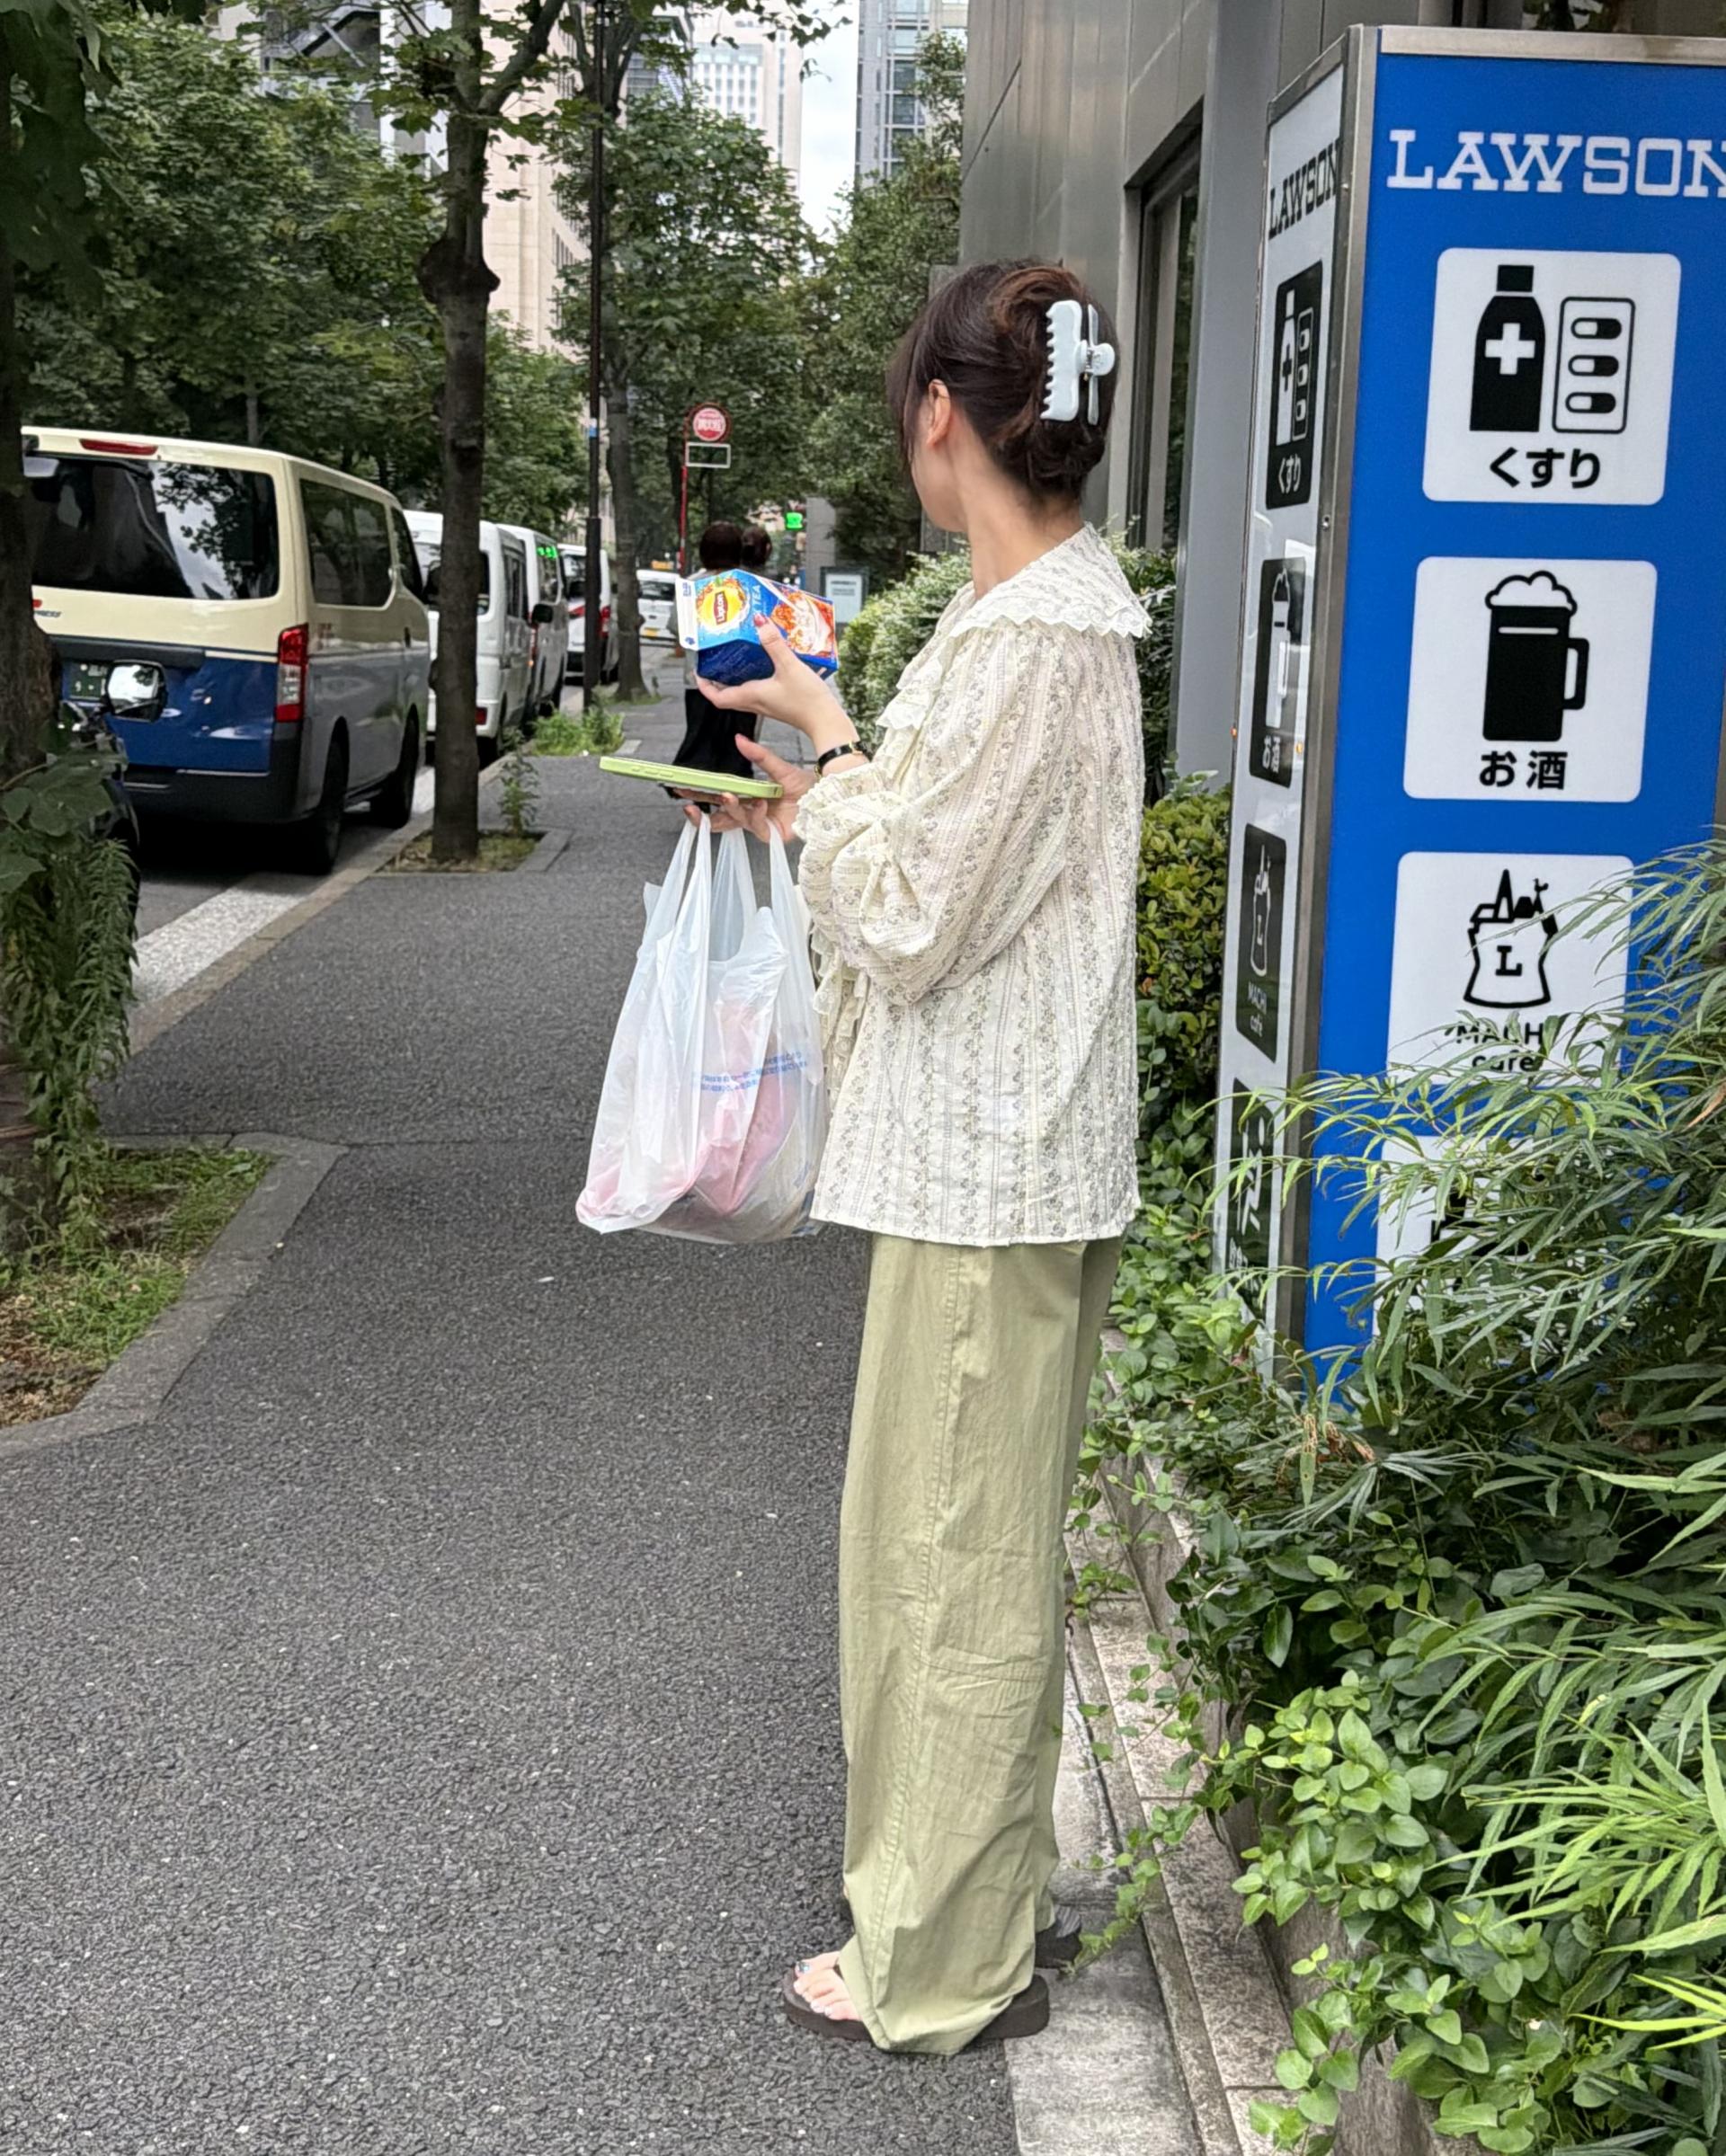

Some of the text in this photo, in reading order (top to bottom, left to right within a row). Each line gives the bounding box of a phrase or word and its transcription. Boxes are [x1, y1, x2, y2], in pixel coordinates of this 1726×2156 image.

[1387, 129, 1726, 198] LAWSON
[1268, 138, 1339, 240] LAWSON
[1277, 454, 1301, 493] くすり
[1490, 447, 1600, 489] くすり
[1479, 750, 1568, 790] お酒
[1495, 945, 1523, 977] L
